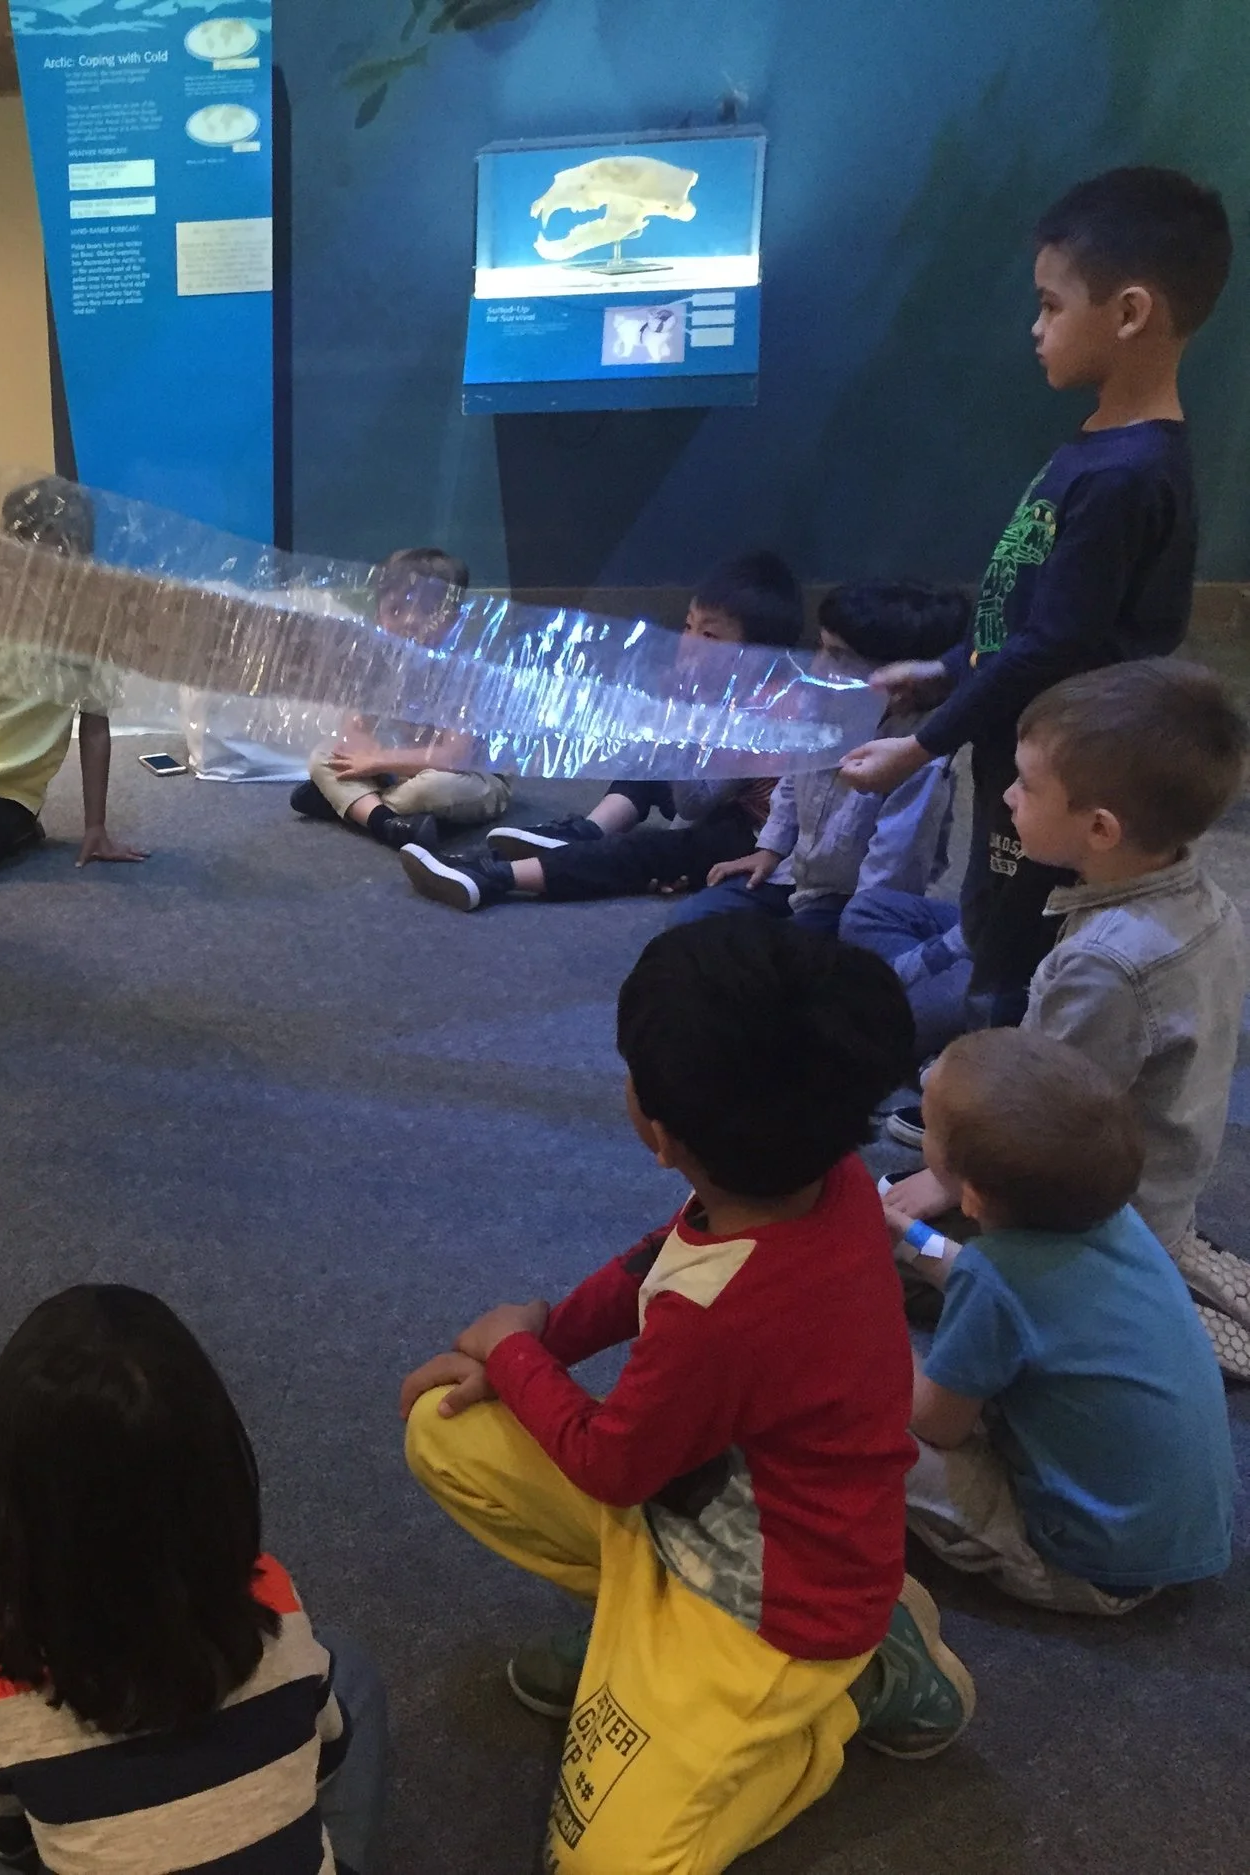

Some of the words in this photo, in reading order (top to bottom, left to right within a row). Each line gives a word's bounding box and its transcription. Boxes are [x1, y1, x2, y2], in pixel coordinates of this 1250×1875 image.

[78, 54, 116, 68] Coping
[117, 51, 141, 64] with
[143, 50, 169, 64] Cold
